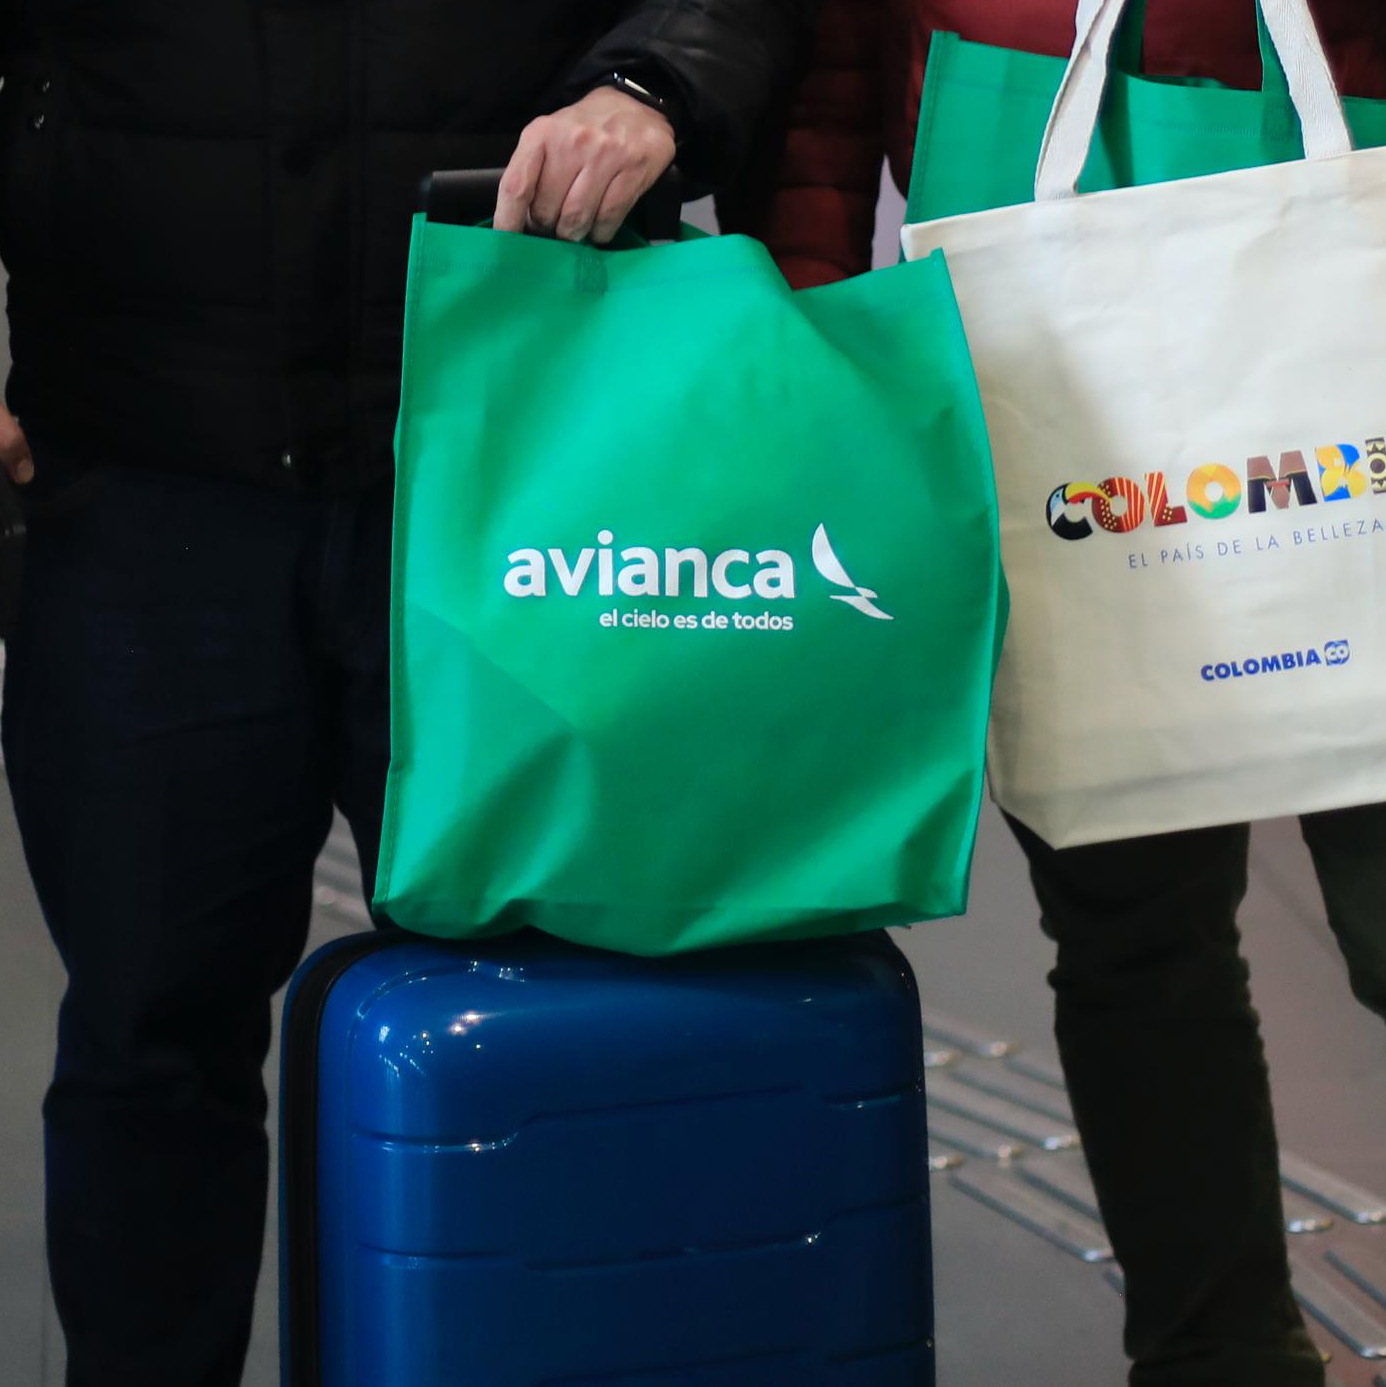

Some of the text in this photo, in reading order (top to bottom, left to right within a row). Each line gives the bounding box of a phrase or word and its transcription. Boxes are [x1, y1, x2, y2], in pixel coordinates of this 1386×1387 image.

[503, 529, 795, 600] avianca
[1128, 518, 1385, 569] EL PAÍS DE LA BELLEZA
[598, 608, 794, 631] el cielo es de todos
[1201, 648, 1322, 682] COLOMBIA
